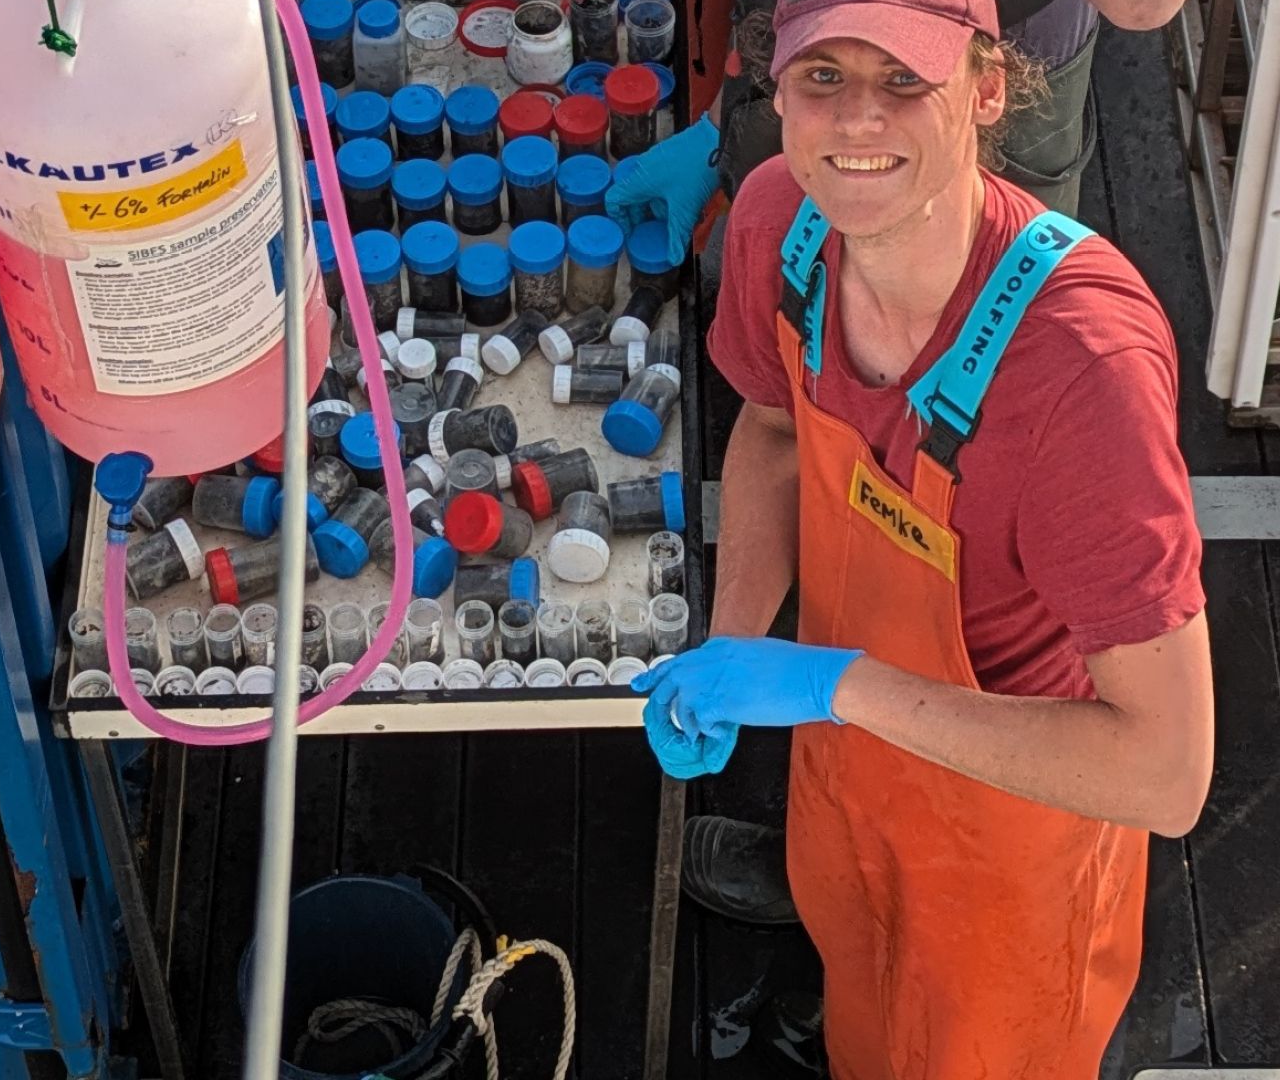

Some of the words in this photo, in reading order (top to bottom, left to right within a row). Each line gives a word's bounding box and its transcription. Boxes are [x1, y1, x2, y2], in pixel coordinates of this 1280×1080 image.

[4, 141, 200, 183] KAUTEX
[113, 197, 148, 219] 6%
[127, 243, 168, 262] SIBES
[170, 223, 217, 253] sample
[219, 169, 278, 234] preservation
[961, 254, 1038, 376] DOLFING
